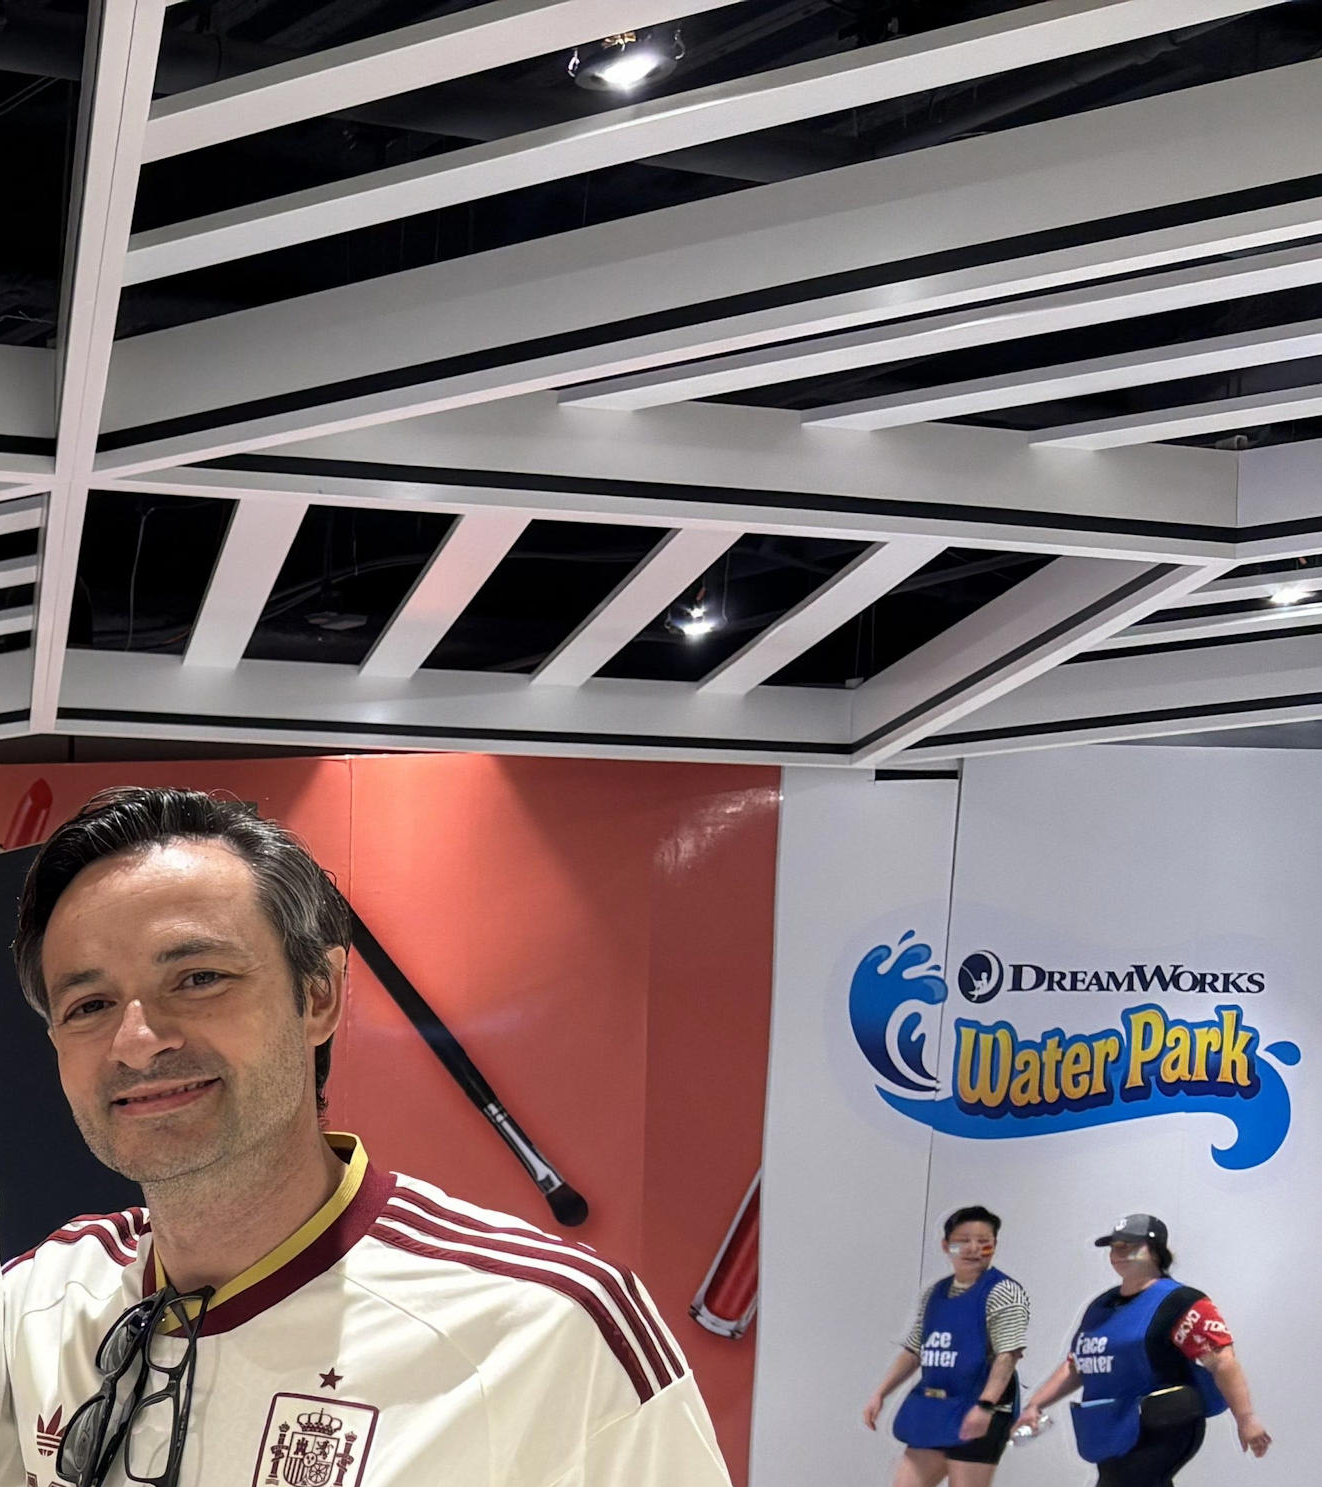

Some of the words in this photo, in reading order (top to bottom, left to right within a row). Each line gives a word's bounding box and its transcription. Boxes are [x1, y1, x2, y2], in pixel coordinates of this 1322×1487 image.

[958, 1024, 1120, 1108] Water
[1125, 1009, 1253, 1090] Park
[1174, 1309, 1201, 1345] OKYO
